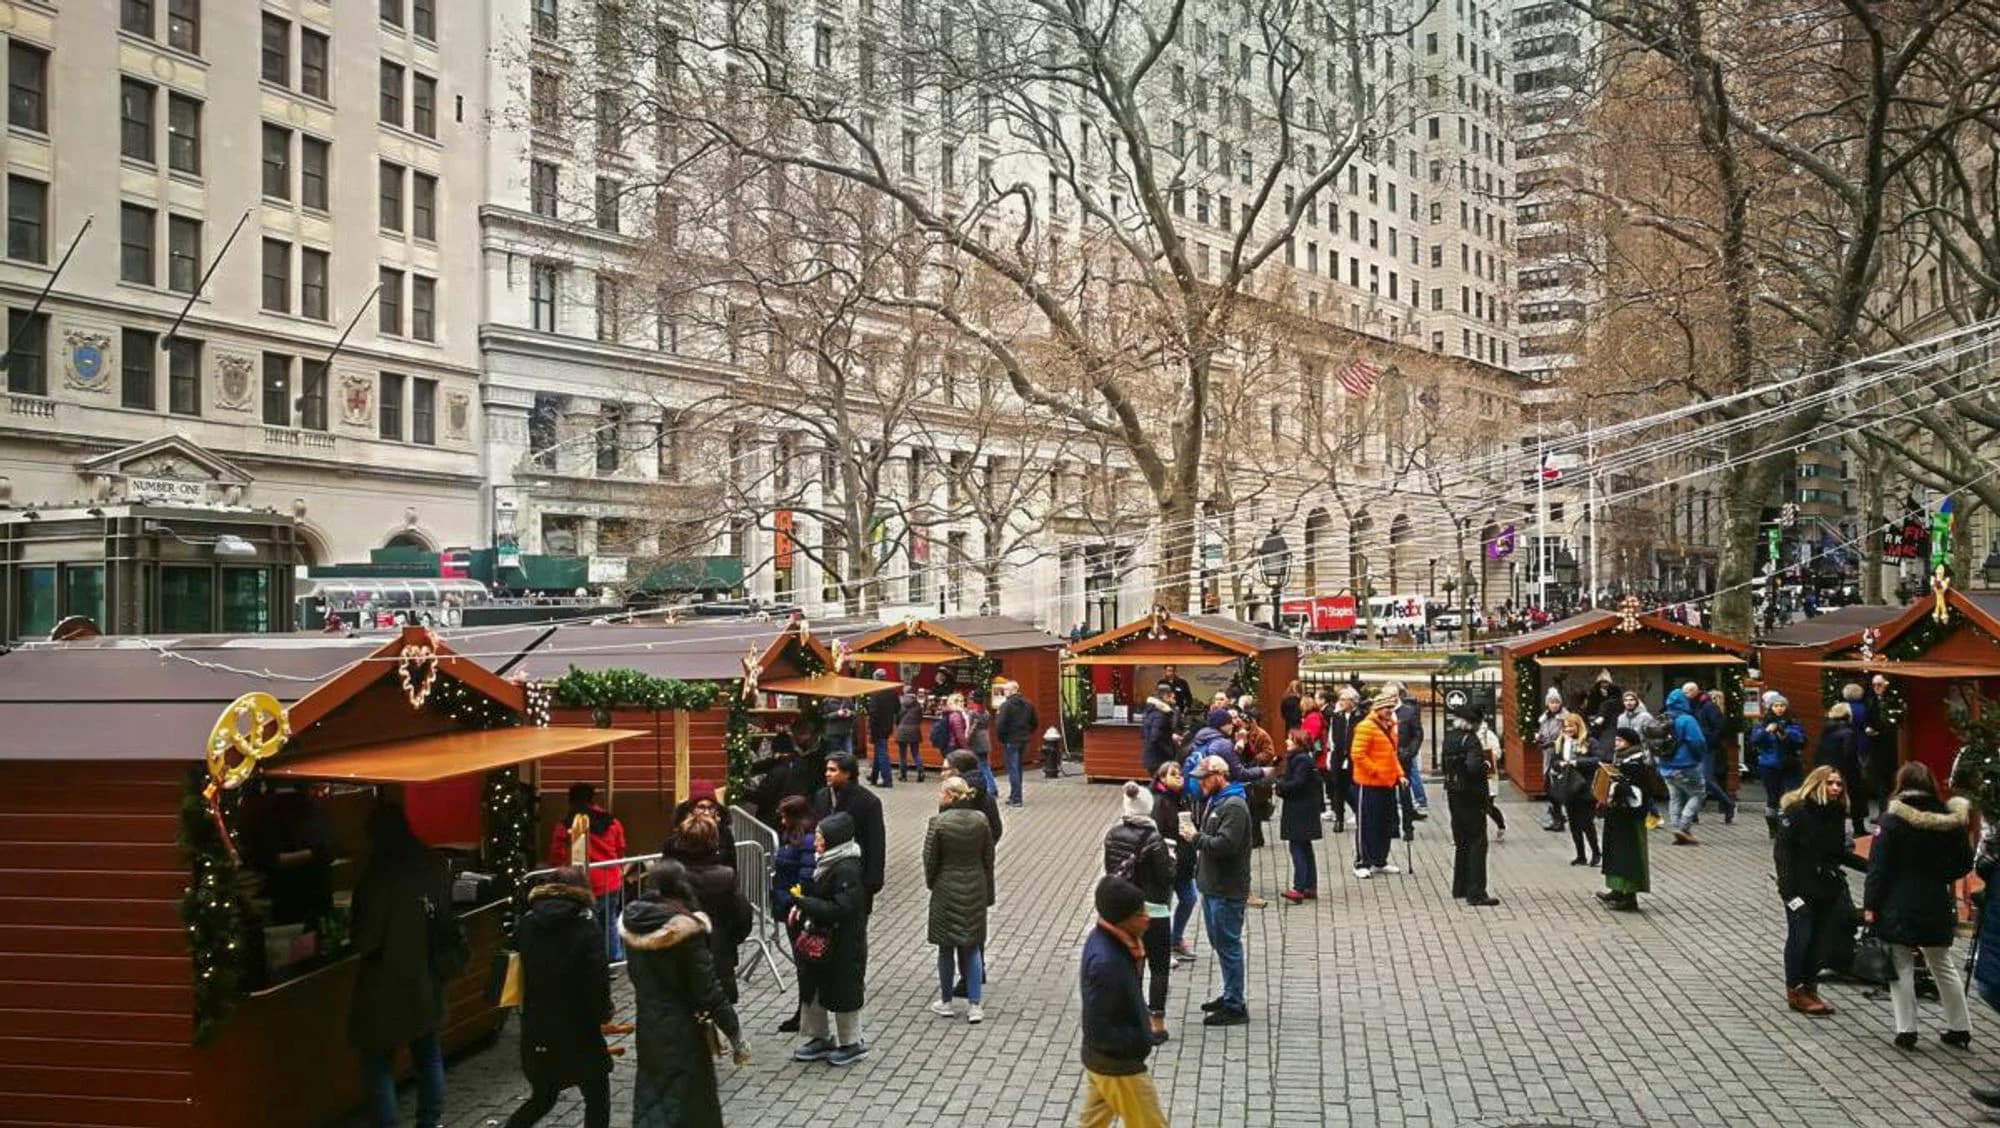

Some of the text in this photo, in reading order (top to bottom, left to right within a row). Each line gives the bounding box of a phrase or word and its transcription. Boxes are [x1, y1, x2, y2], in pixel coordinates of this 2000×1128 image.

[133, 480, 201, 496] NUMBER ONE
[1392, 598, 1422, 618] FedEx
